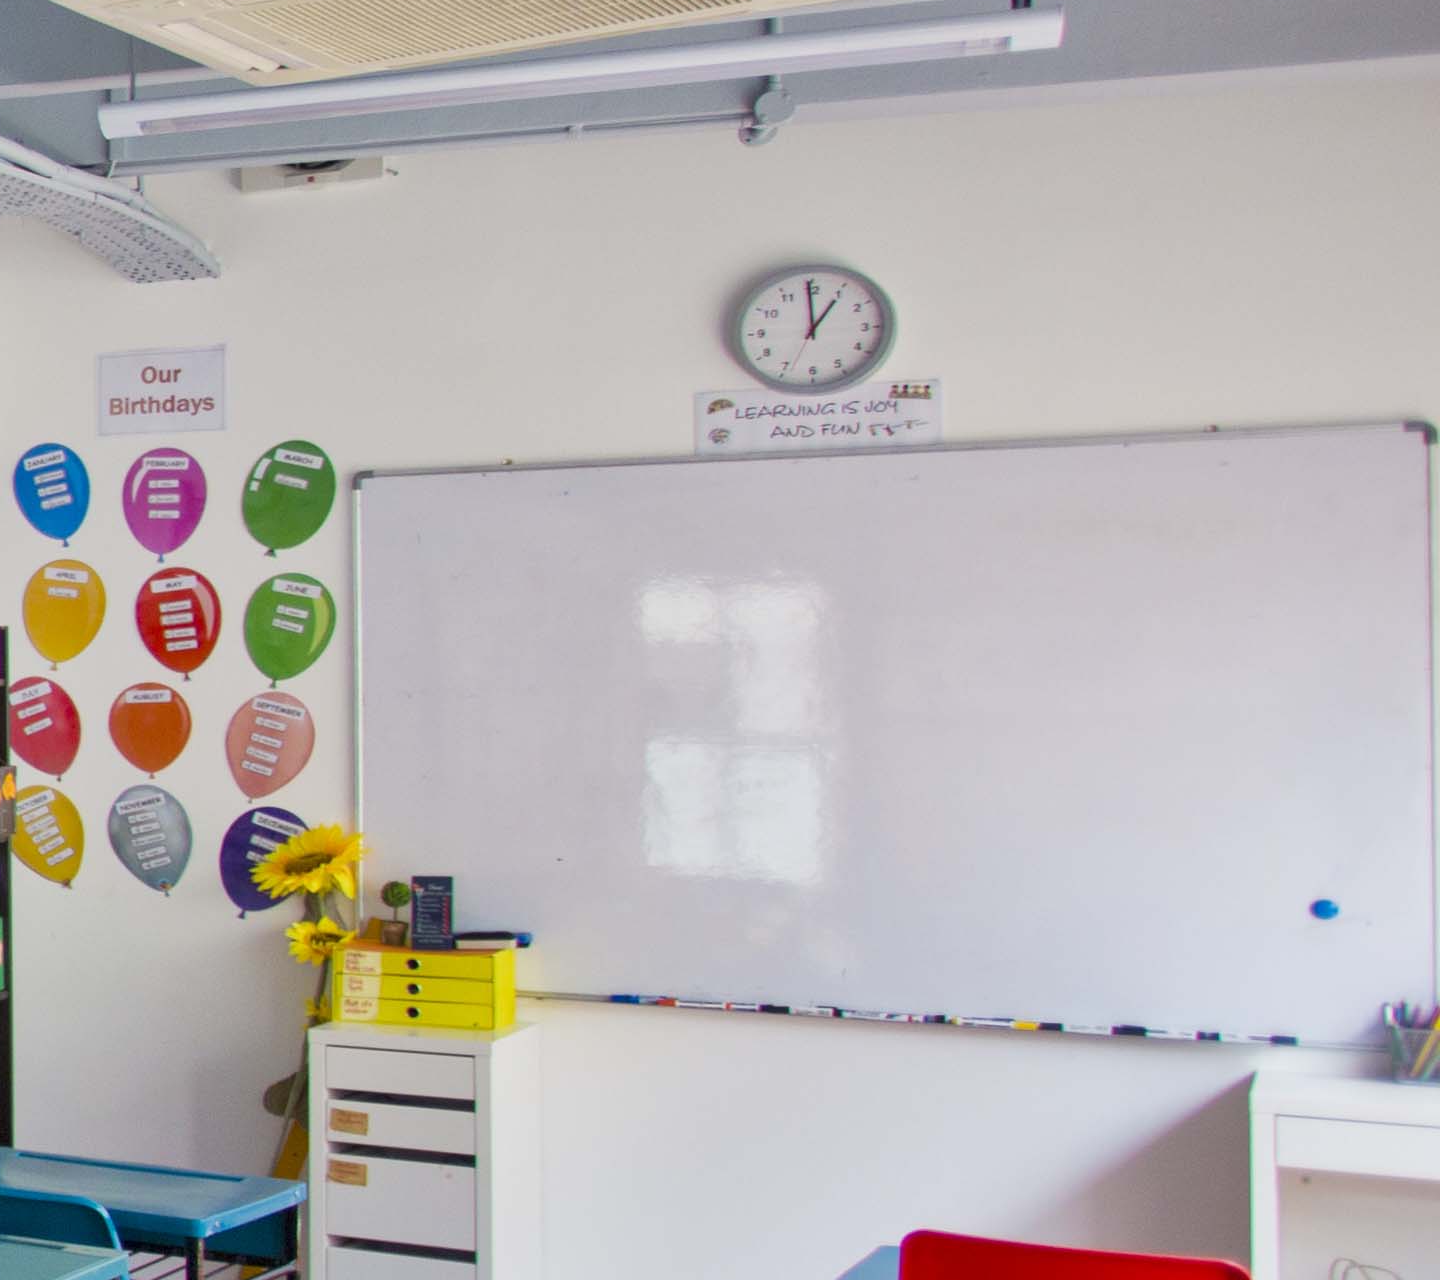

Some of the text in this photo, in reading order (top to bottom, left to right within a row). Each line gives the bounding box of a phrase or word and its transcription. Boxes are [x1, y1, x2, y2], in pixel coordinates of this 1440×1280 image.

[141, 365, 182, 385] Our
[108, 395, 214, 417] Birthdays
[735, 400, 898, 420] LEARNING IS JOY
[770, 423, 860, 438] AND FUN
[284, 454, 314, 465] MARCH
[255, 701, 302, 717] SEPTEMBER
